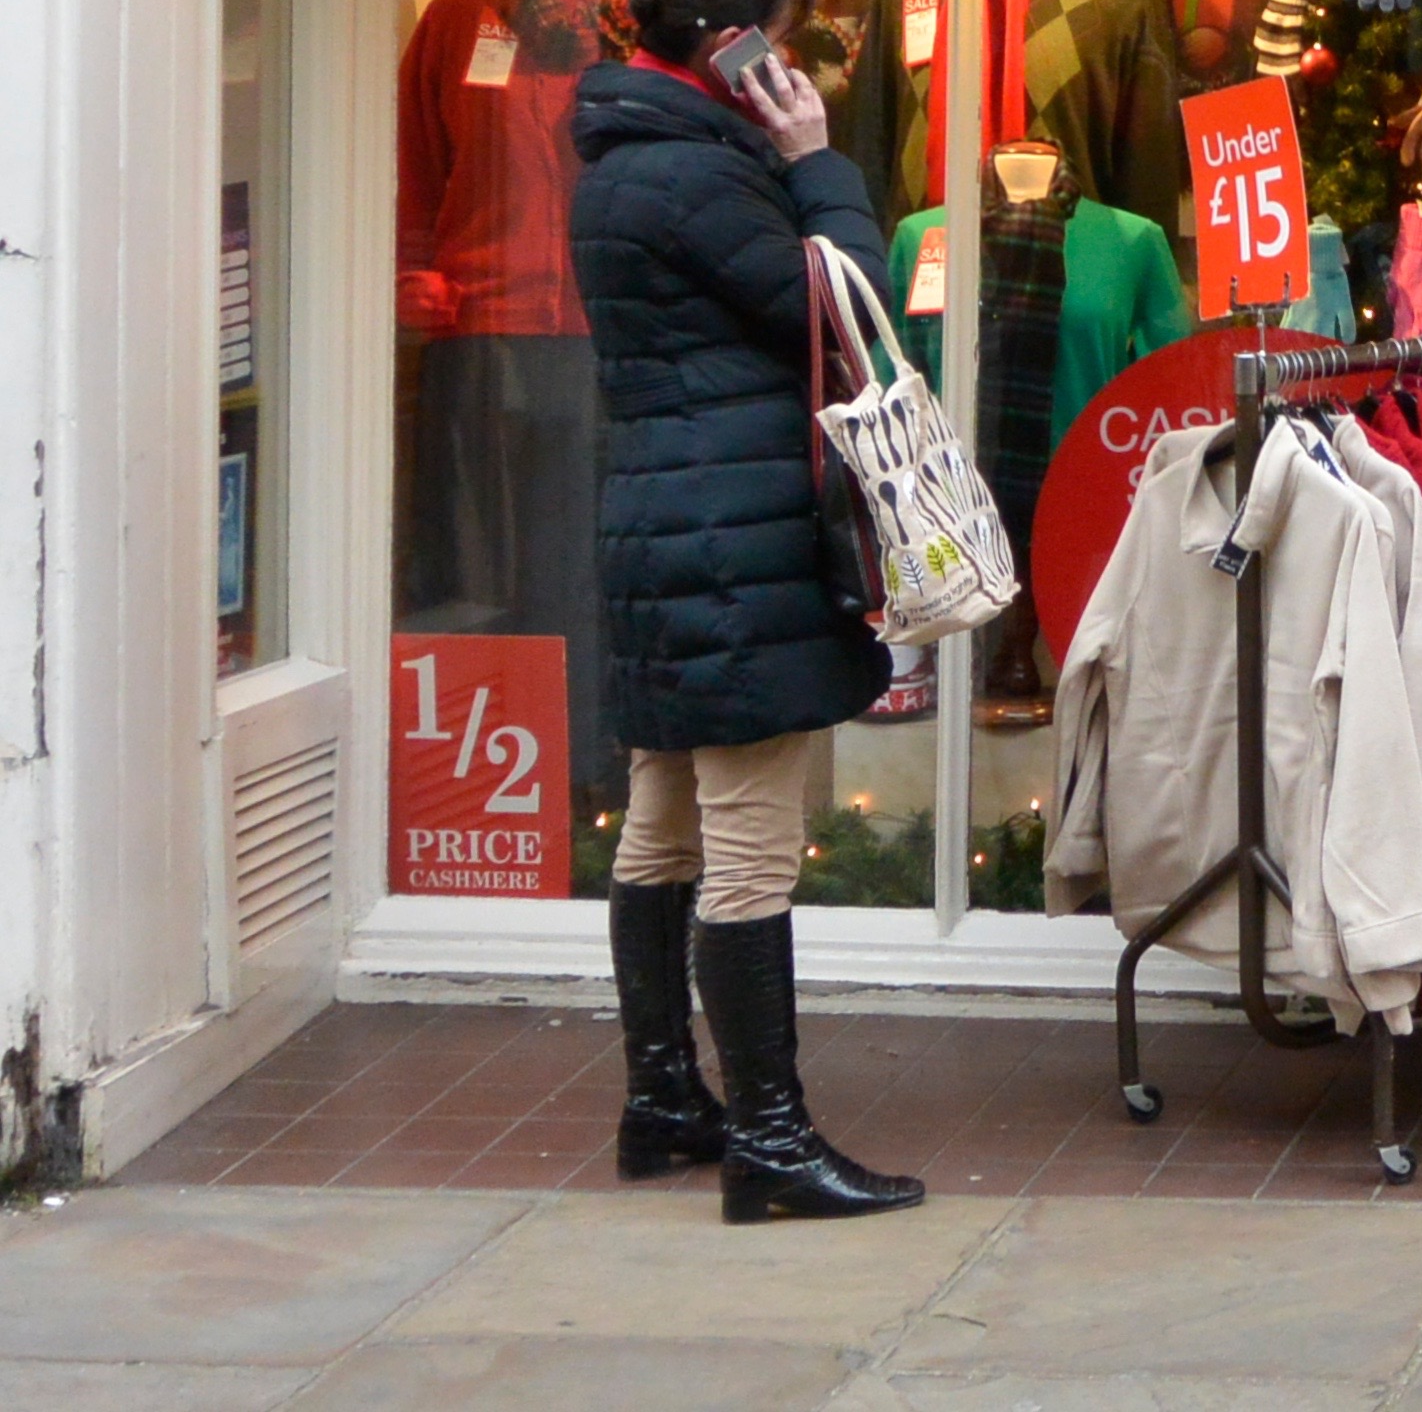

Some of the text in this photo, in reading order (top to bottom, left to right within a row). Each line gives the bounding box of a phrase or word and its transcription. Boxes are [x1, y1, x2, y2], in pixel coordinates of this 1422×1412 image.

[1202, 124, 1282, 167] Under
[1209, 165, 1291, 264] £15
[401, 654, 541, 814] 1/2
[406, 829, 542, 865] PRICE
[409, 870, 540, 890] CASHMERE
